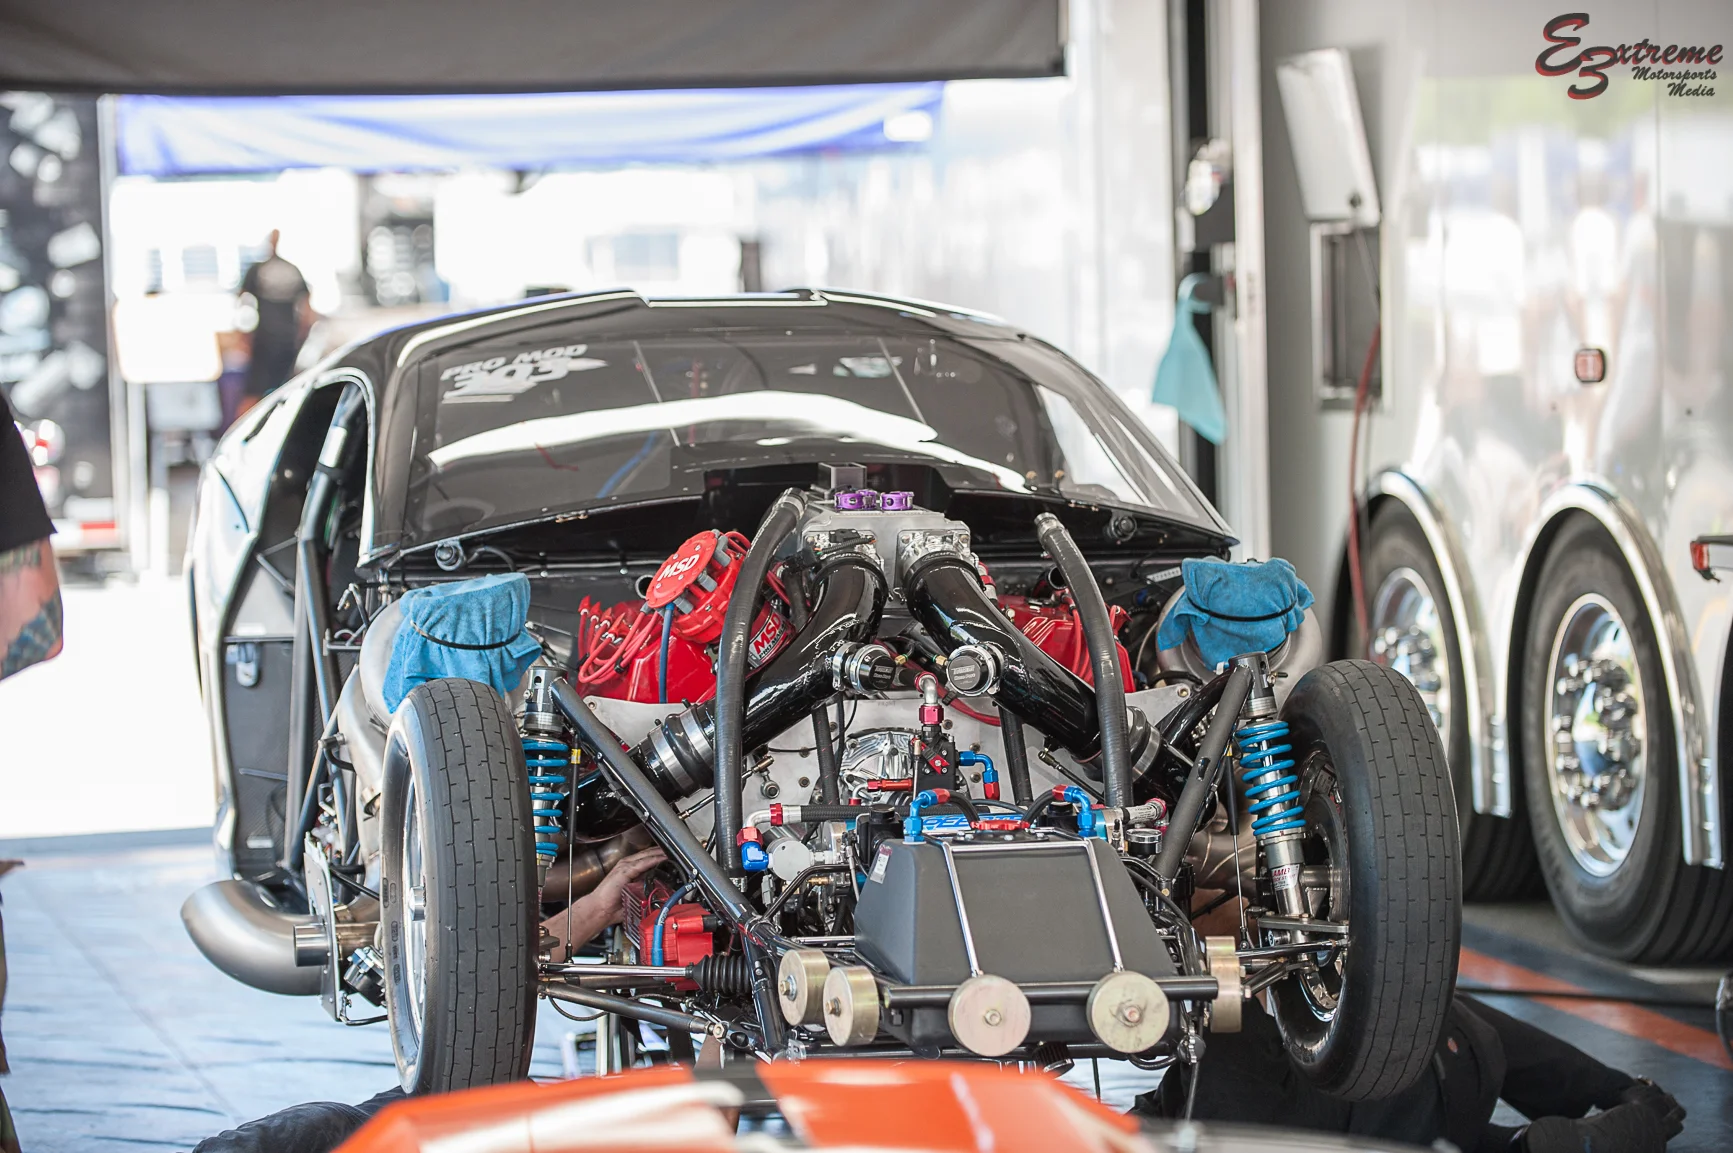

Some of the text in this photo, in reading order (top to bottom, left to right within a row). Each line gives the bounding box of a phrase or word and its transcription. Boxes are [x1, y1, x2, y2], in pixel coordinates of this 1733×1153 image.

[440, 344, 588, 381] PRO MOD
[657, 554, 700, 582] MSD
[753, 612, 781, 655] MSD
